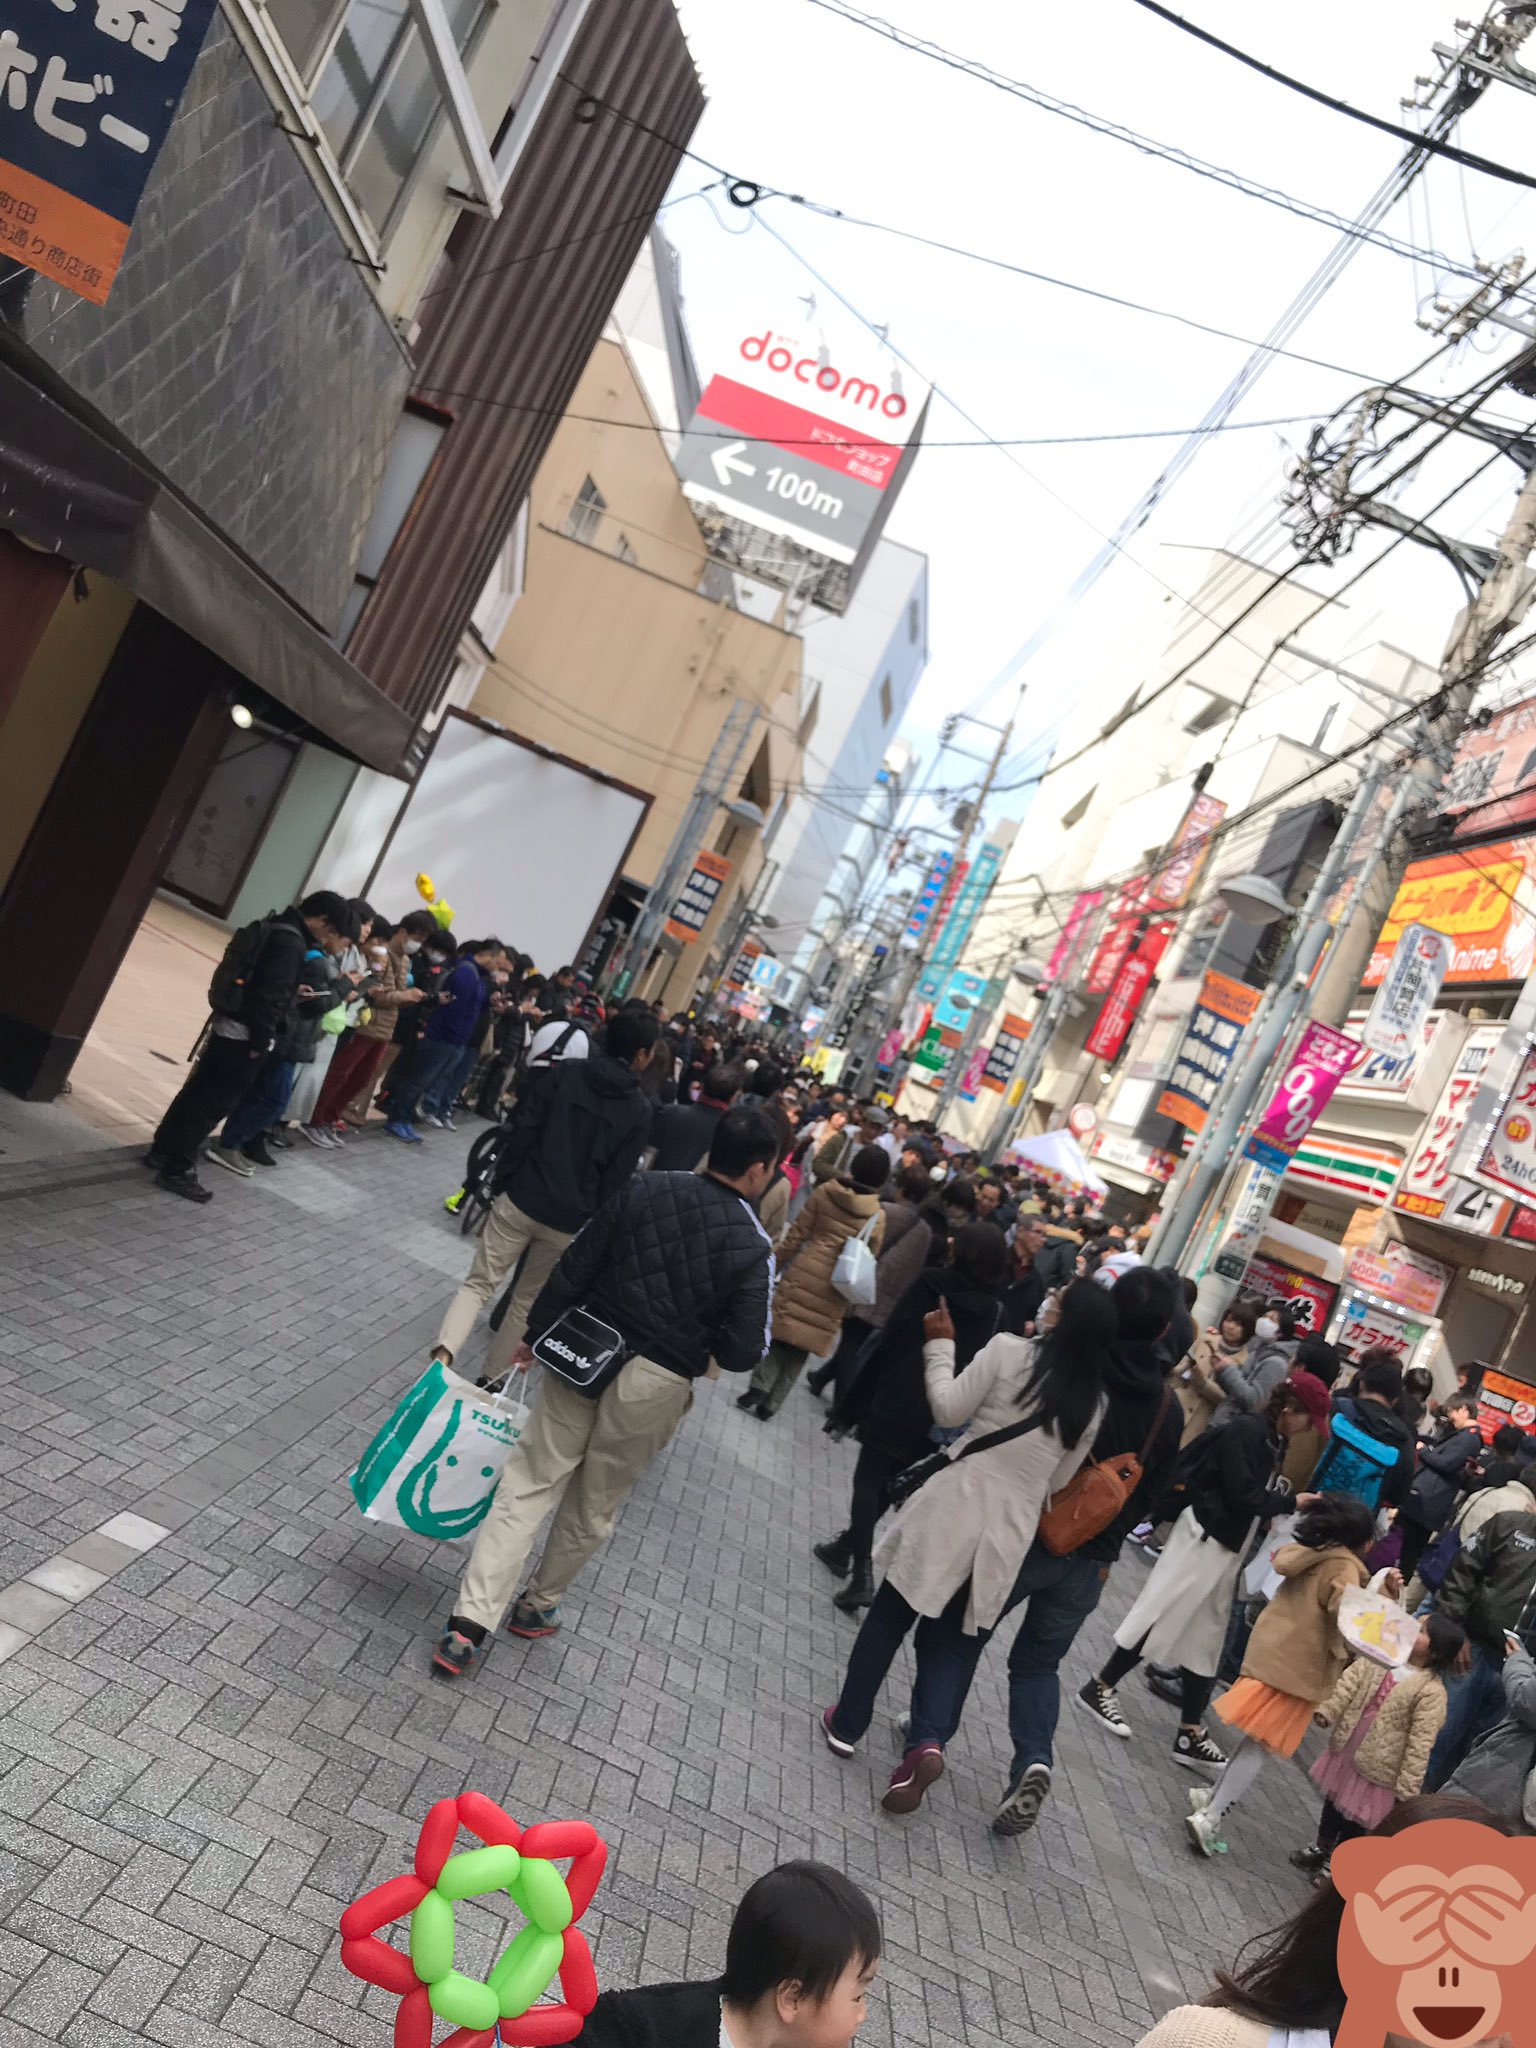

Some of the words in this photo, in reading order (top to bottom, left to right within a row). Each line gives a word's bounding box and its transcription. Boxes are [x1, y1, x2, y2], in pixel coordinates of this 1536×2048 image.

[0, 191, 38, 225] 町田
[740, 330, 907, 419] docomo
[809, 426, 892, 466] ドコモショップ
[765, 466, 844, 519] 100m
[543, 1337, 577, 1365] adidas
[1345, 1322, 1411, 1355] カラオケ
